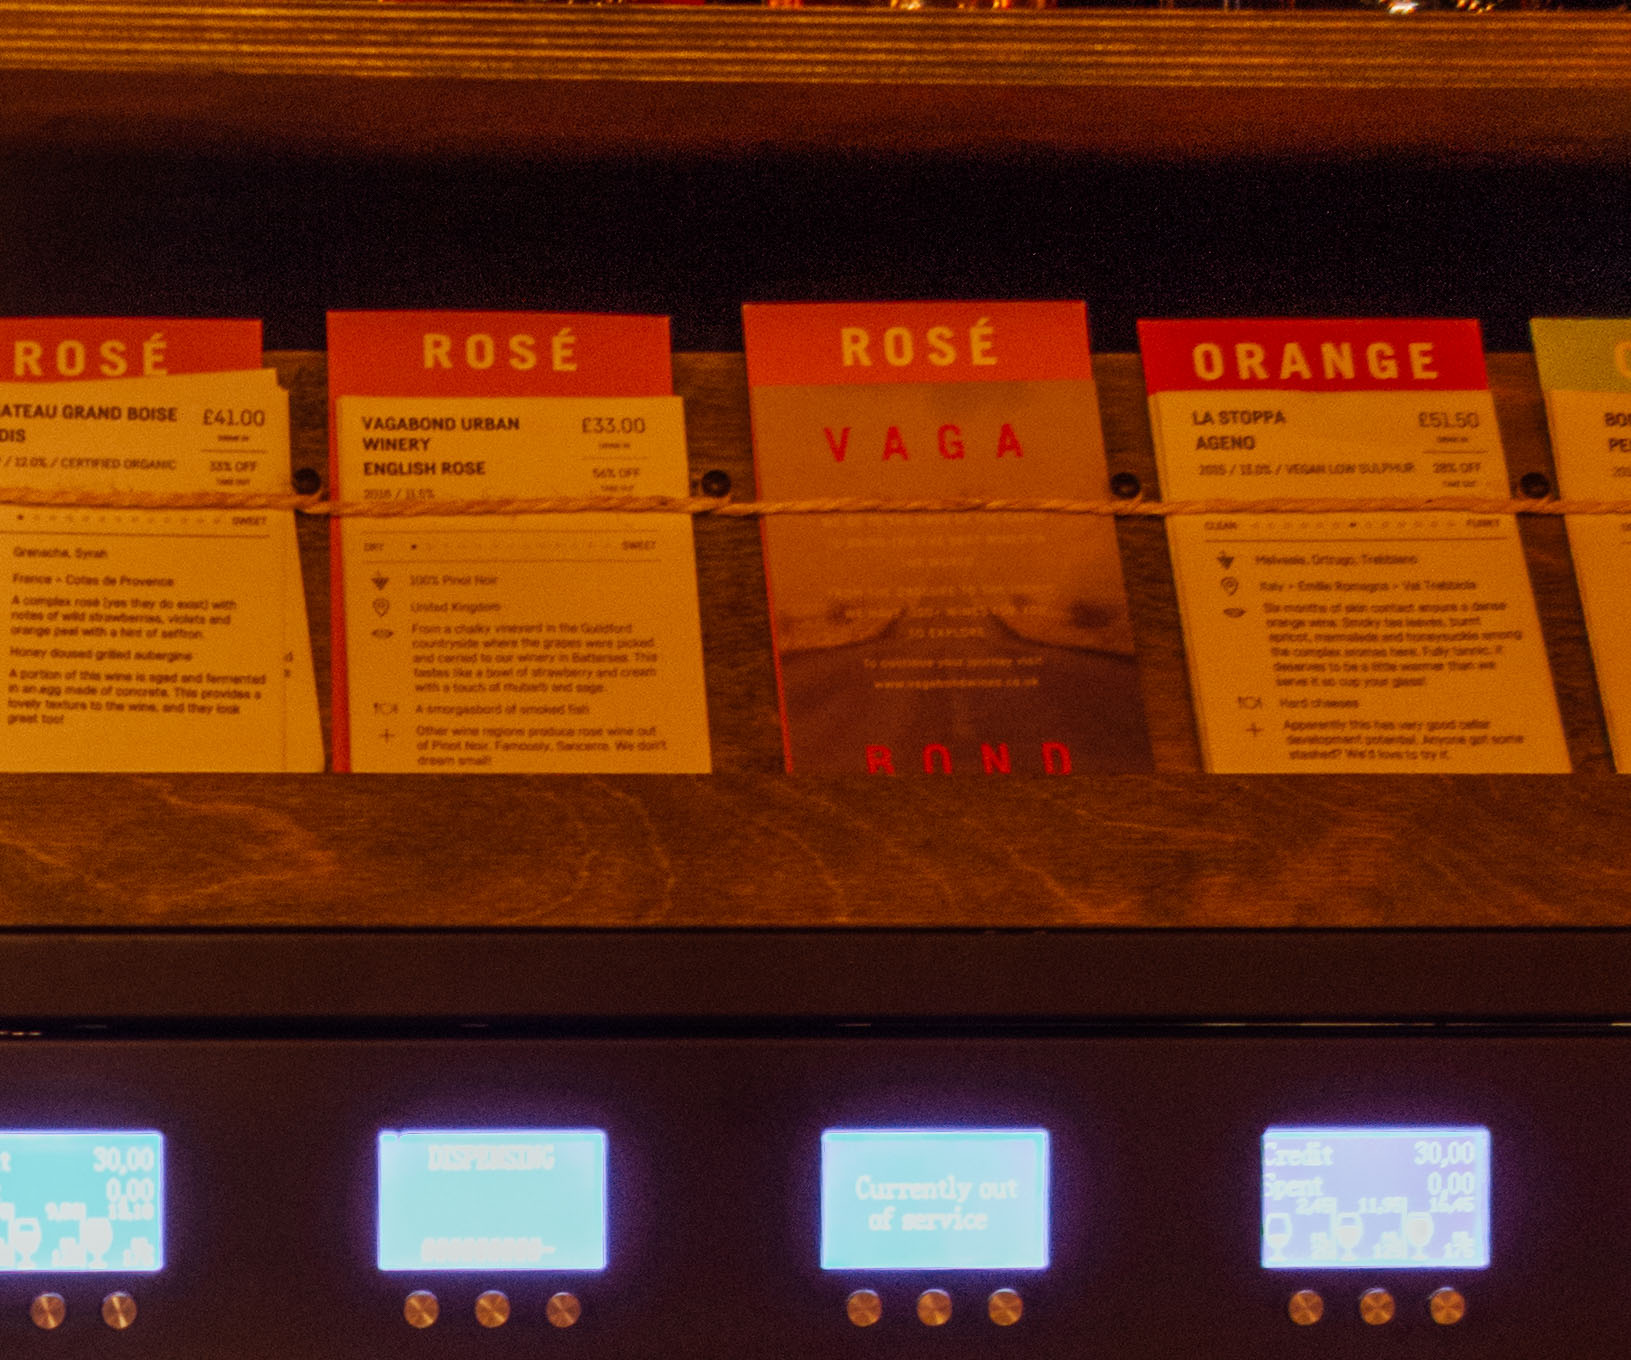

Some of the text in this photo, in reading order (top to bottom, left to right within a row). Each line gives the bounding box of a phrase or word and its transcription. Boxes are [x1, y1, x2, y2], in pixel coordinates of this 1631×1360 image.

[423, 327, 578, 371] ROSÉ
[841, 316, 999, 368] ROSÉ
[13, 333, 169, 376] ROSÉ
[1192, 342, 1438, 381] ORANGE
[62, 405, 121, 420] GRAND
[128, 407, 178, 422] BOISE
[202, 409, 265, 427] £41.00
[1191, 410, 1286, 426] LA STOPPA
[1418, 412, 1479, 428] £51.50
[362, 417, 520, 431] VAGABOND URBAN
[582, 417, 646, 434] £33.00
[363, 438, 430, 451] WINERY
[824, 423, 1024, 462] VAGA
[1196, 435, 1255, 450] AGENO
[4, 457, 12, 468] /
[49, 457, 59, 468] /
[60, 457, 120, 469] CERTIFIED
[123, 458, 177, 470] ORGANIC
[235, 461, 258, 472] OFF
[364, 462, 486, 476] ENGLISH ROSE
[619, 468, 640, 478] OFF
[232, 516, 267, 526] SWEET
[622, 540, 656, 550] SWEET
[13, 574, 52, 584] France
[120, 575, 174, 586] Provence
[442, 575, 471, 585] Pinot
[475, 575, 498, 585] Noir
[23, 597, 71, 607] complex
[131, 598, 155, 609] they
[159, 599, 173, 608] do
[212, 600, 237, 609] with
[410, 602, 501, 614] United Kingdom
[11, 612, 43, 621] notes
[47, 611, 59, 620] of
[62, 612, 85, 621] wild
[169, 614, 205, 624] violets
[210, 615, 231, 624] and
[10, 627, 50, 638] orange
[54, 627, 78, 637] peel
[81, 627, 107, 637] with
[120, 627, 142, 637] hint
[146, 628, 158, 637] of
[9, 646, 47, 658] Honey
[134, 651, 192, 663] aubergine
[568, 704, 590, 714] fish
[93, 1146, 155, 1176] 30,00
[1265, 1141, 1334, 1167] Credit
[1414, 1141, 1475, 1168] 30,00
[856, 1175, 1017, 1203] Currently out
[1264, 1172, 1323, 1200] Spent
[869, 1206, 988, 1231] of service
